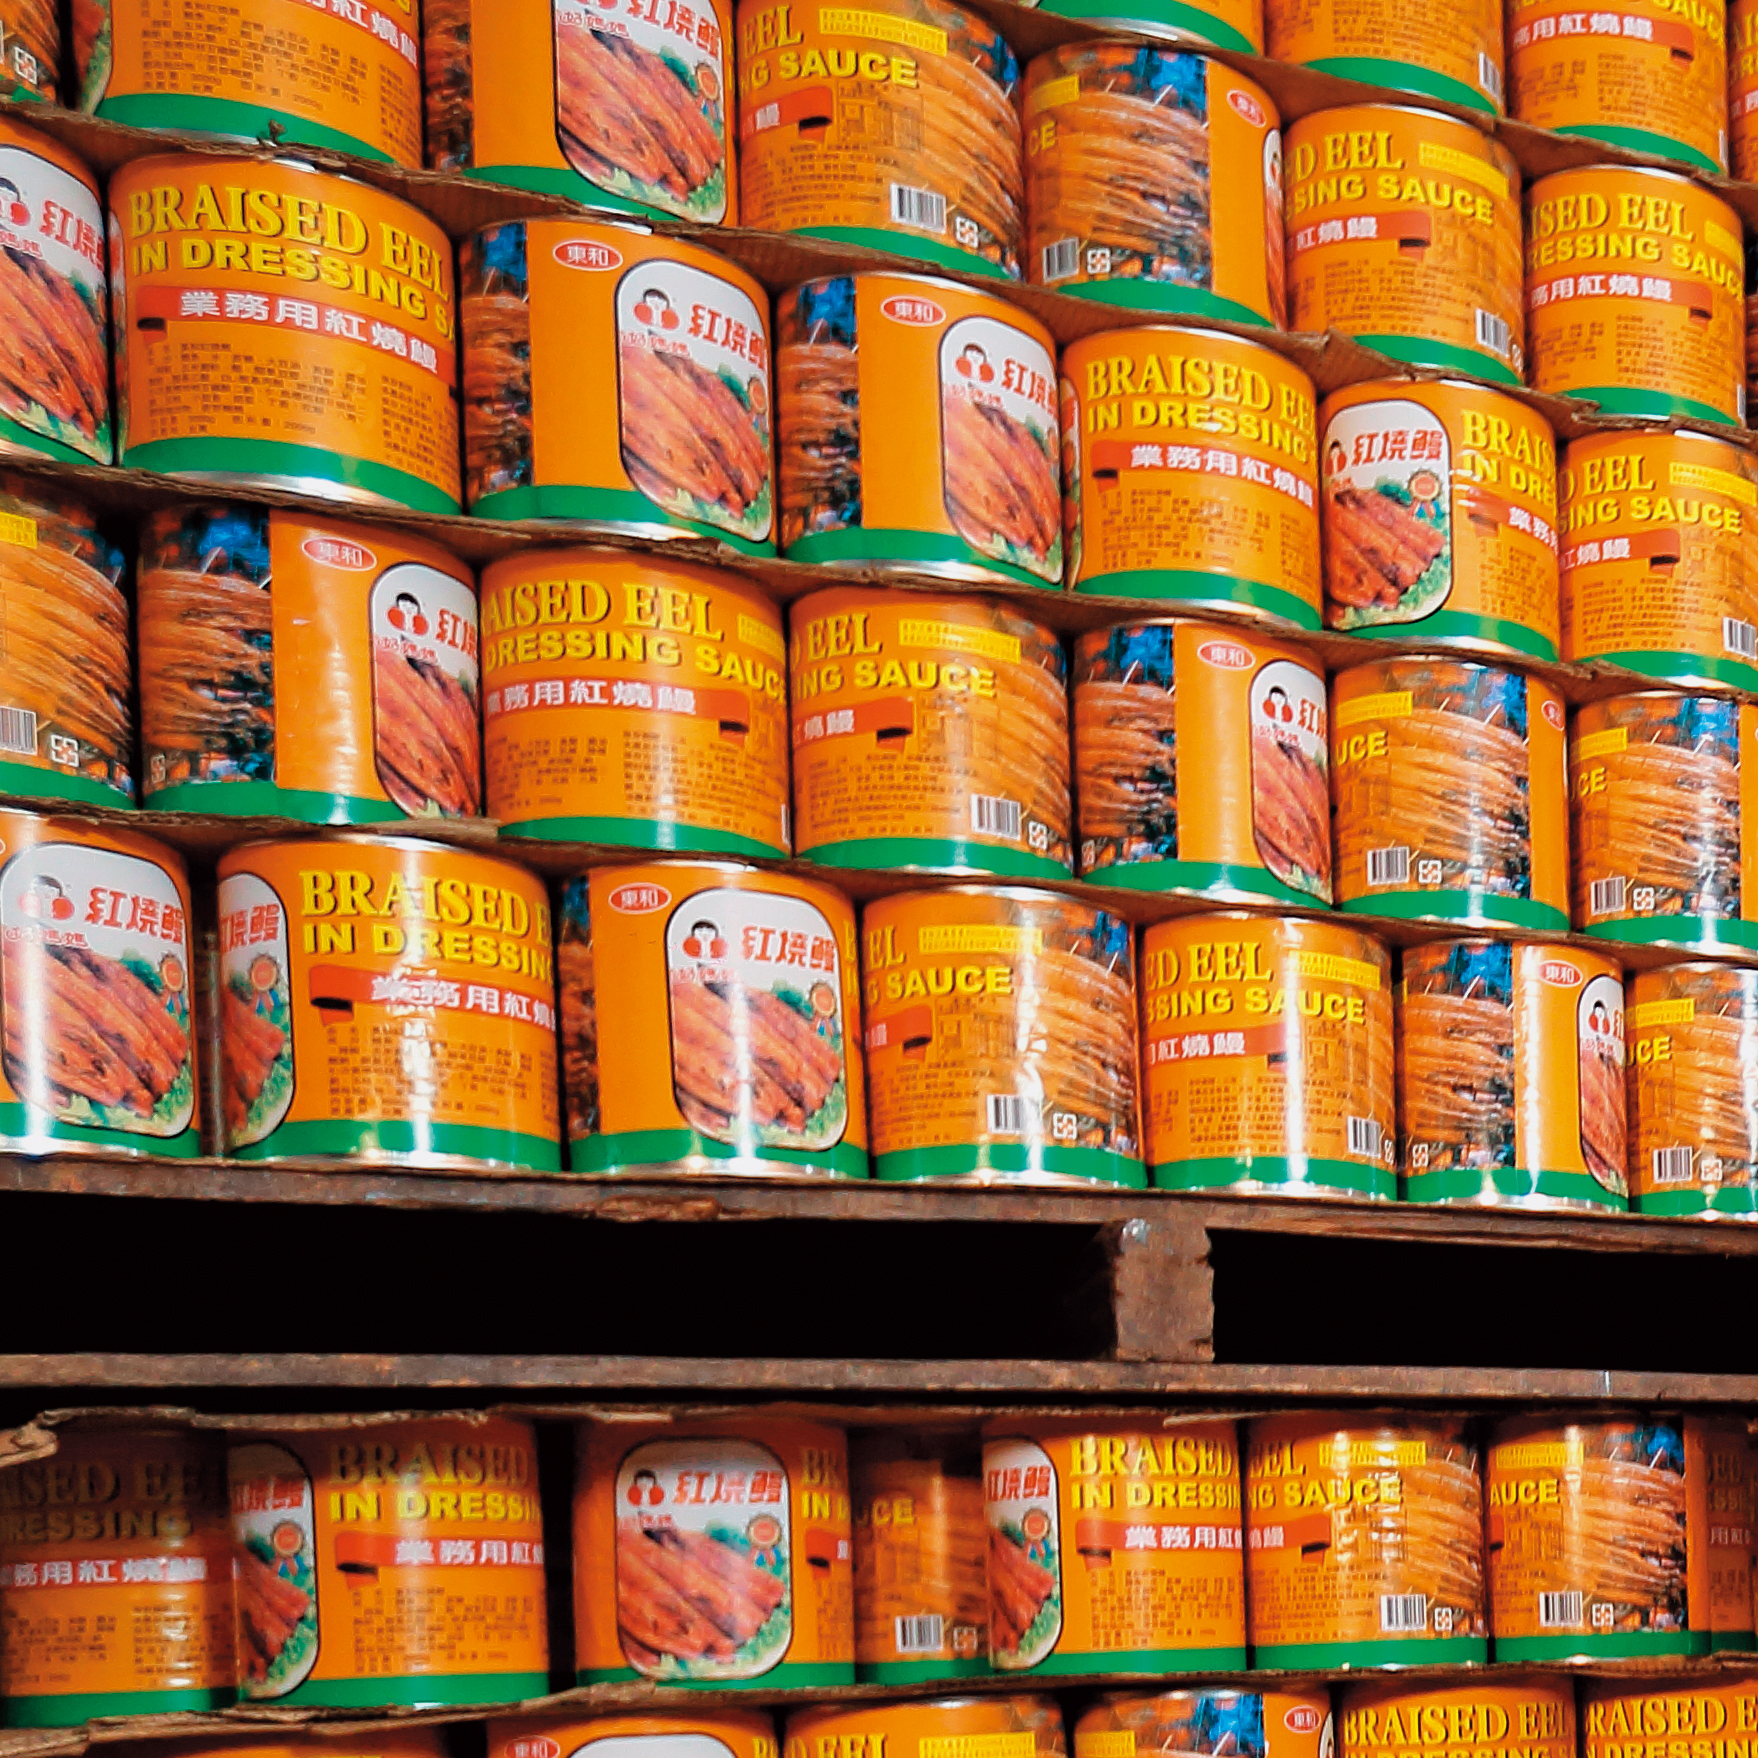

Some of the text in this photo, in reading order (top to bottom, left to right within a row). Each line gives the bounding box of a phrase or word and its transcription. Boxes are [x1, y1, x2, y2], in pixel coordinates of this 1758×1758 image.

[780, 50, 919, 87] SAUCE
[1324, 130, 1405, 169] EEL
[1377, 178, 1496, 228] SAUCE
[1618, 192, 1696, 242] EEL
[129, 186, 450, 301] BRAISED EEL
[564, 242, 611, 270] 東和
[132, 238, 428, 318] IN DRESSING
[180, 289, 439, 375] 業務用紅燒鰻
[894, 301, 935, 323] 東和
[1084, 353, 1271, 414] BRAISED
[1086, 401, 1309, 462] IN DRESSING
[1352, 428, 1443, 467] 紅燒鰻
[1464, 454, 1499, 485] IN
[1574, 455, 1655, 499] EEL
[1630, 495, 1741, 535] SAUCE
[316, 542, 365, 567] 東和
[623, 583, 724, 642] EEL
[806, 613, 882, 660] EEL
[859, 663, 997, 698] SAUCE
[85, 883, 184, 944] 紅燒鰻
[300, 868, 530, 939] BRAISED
[619, 888, 660, 910] 東和
[303, 922, 355, 954] IN
[740, 924, 837, 972] 紅燒鰻
[886, 966, 1014, 999] SAUCE
[1187, 941, 1274, 987] EEL
[1245, 987, 1366, 1024] SAUCE
[1068, 1434, 1233, 1478] BRAISED
[329, 1489, 379, 1522] IN
[1069, 1480, 1117, 1510] IN
[1282, 1477, 1404, 1510] SAUCE
[1343, 1702, 1572, 1747] BRAISED EEL
